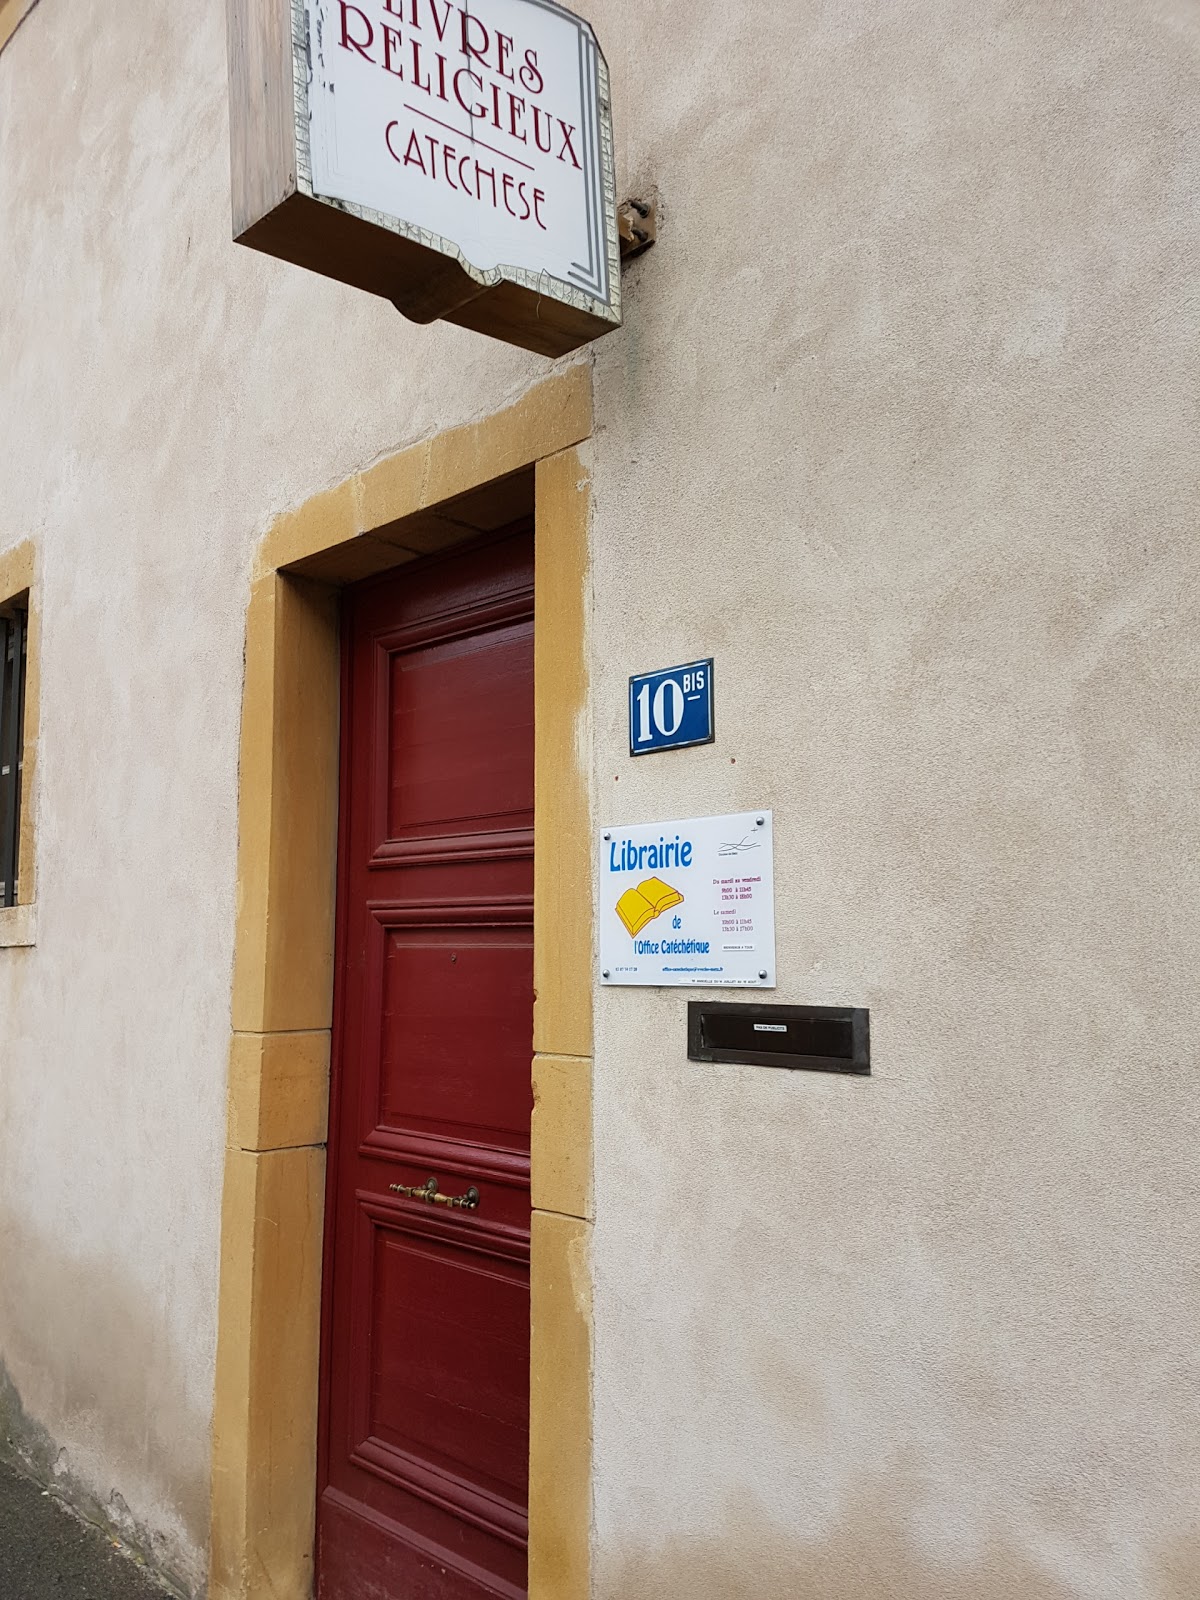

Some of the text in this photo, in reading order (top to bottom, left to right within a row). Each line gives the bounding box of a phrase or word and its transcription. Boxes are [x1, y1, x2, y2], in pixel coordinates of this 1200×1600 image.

[338, 0, 583, 170] RELIGIEUX
[385, 121, 547, 230] CATECHESE
[637, 670, 705, 742] 10 BIS
[610, 835, 692, 872] Librairie
[741, 875, 762, 883] vendredi
[672, 914, 682, 930] de
[634, 938, 710, 955] l'Office Catéchétique
